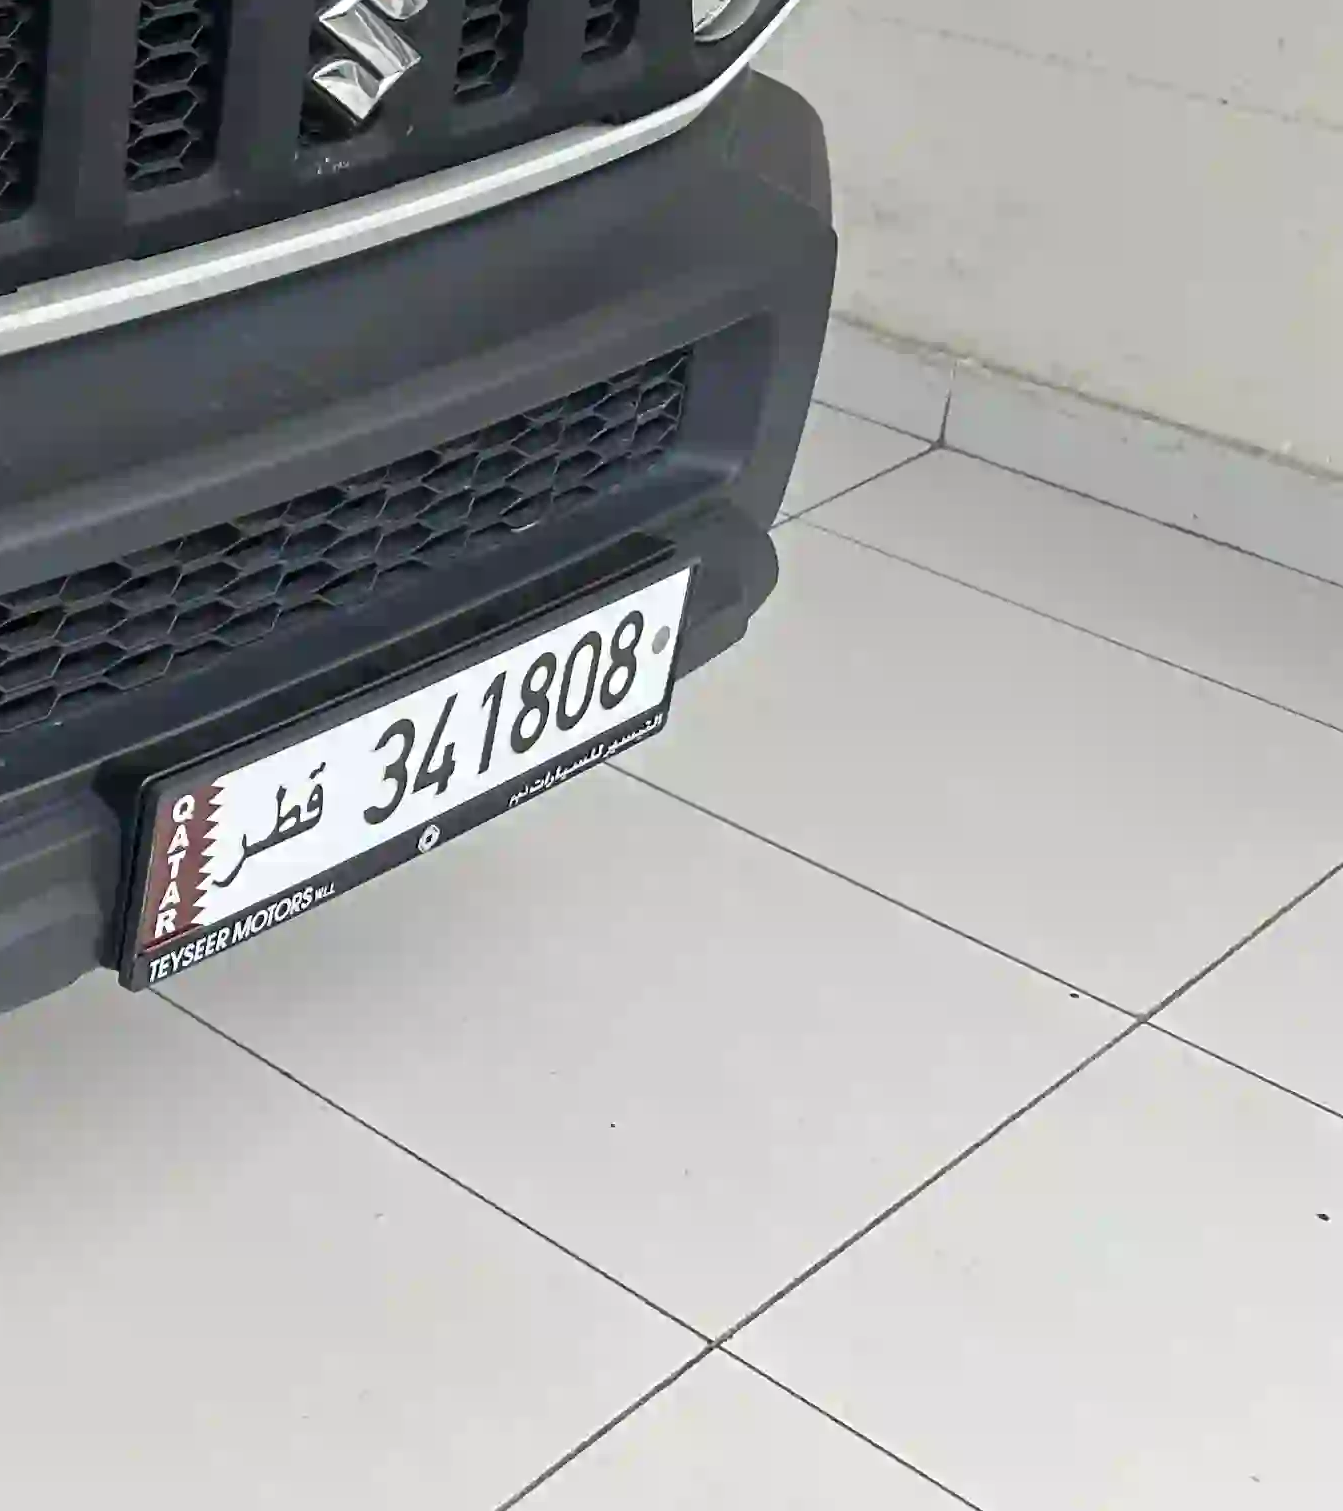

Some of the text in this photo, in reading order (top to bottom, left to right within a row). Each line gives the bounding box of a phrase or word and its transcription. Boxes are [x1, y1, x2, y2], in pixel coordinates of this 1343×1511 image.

[362, 609, 645, 826] 341808
[154, 793, 196, 938] QATAR
[211, 760, 327, 887] قطر
[149, 926, 231, 983] TEYSEER
[230, 885, 314, 944] MOTORS
